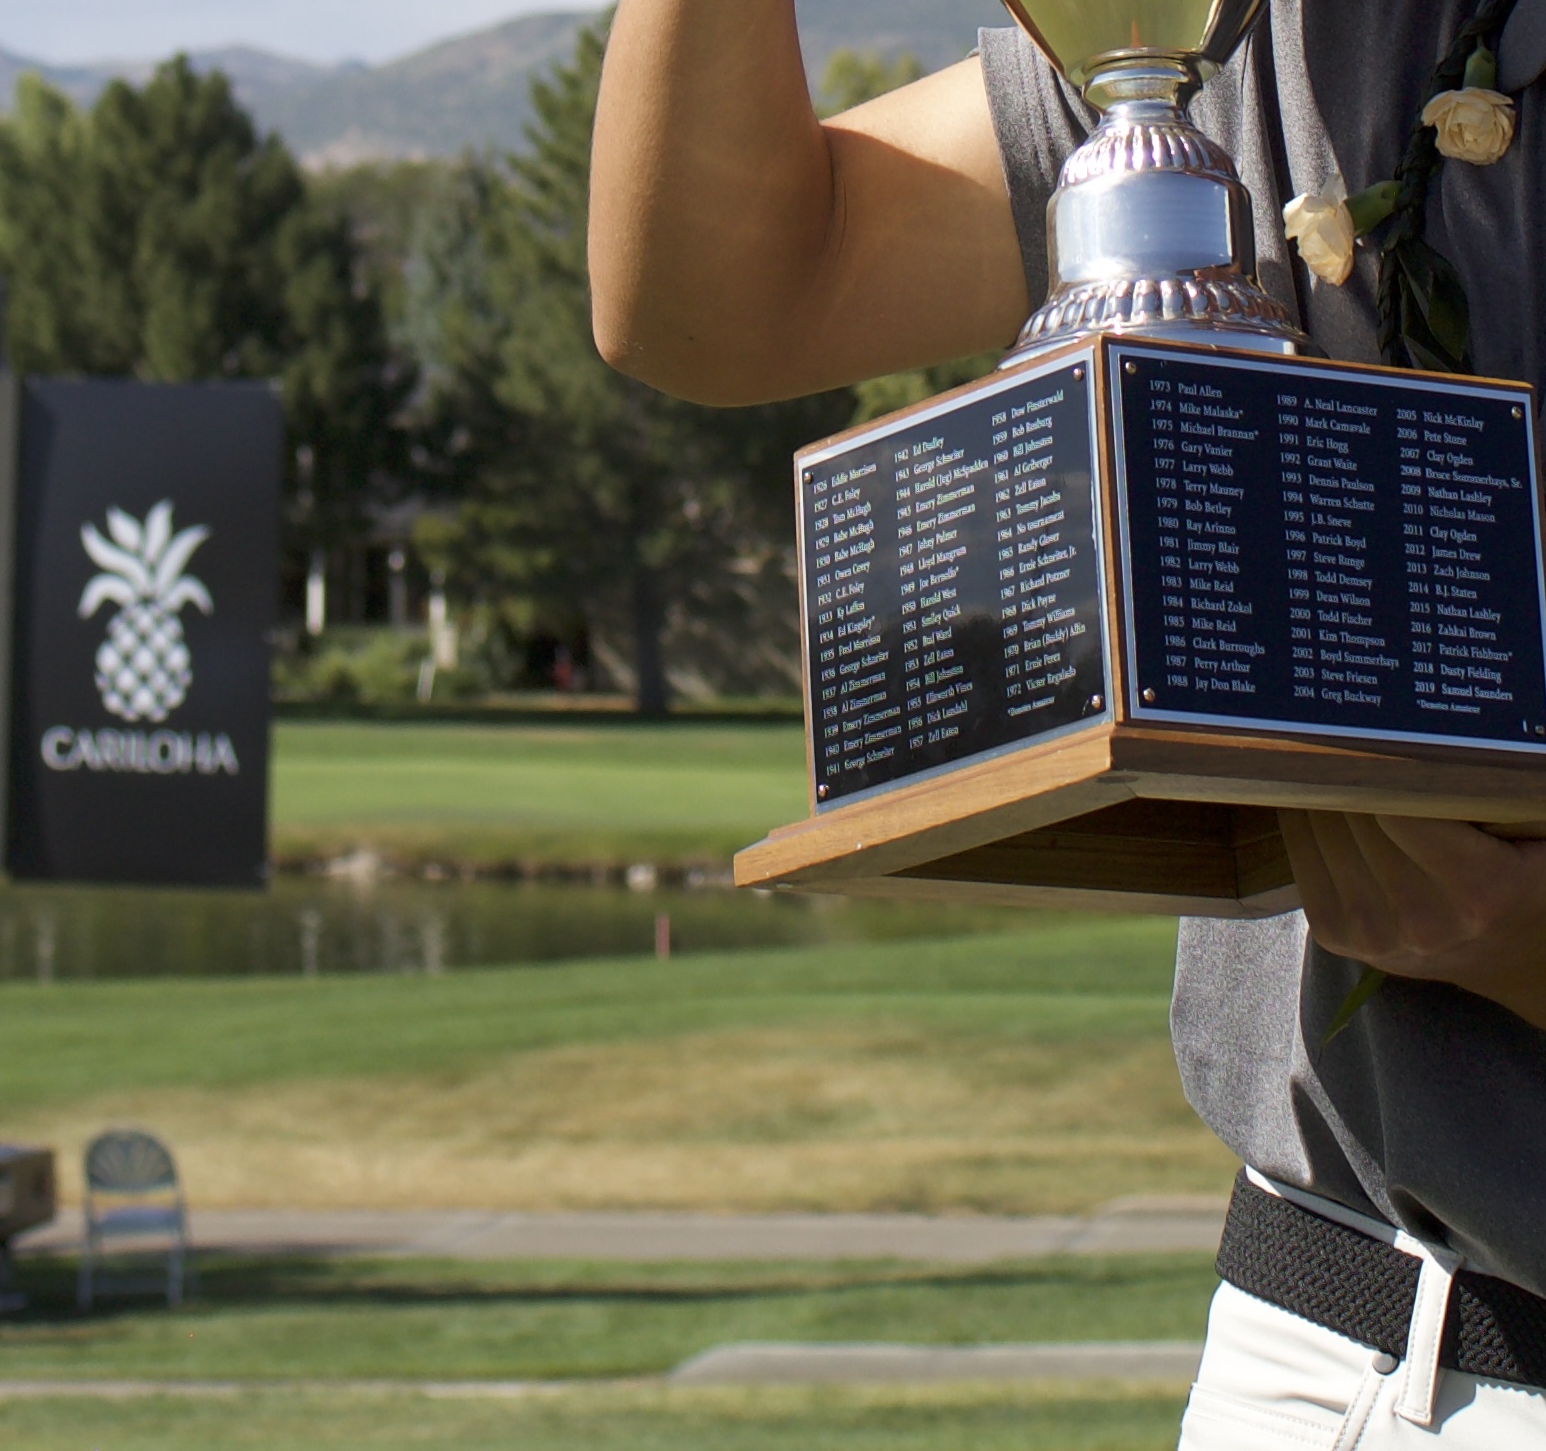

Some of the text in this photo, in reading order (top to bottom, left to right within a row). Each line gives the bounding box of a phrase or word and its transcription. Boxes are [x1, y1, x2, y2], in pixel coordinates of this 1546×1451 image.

[1149, 379, 1170, 392] 1973
[1150, 399, 1171, 411] 1974
[1152, 418, 1172, 430] 1975
[1153, 437, 1174, 450] 1976
[1154, 457, 1174, 469] 1977
[1155, 477, 1176, 489] 1978
[1402, 502, 1423, 514] 2010
[1403, 523, 1422, 535] 2011
[1406, 561, 1426, 573] 2013
[1410, 621, 1431, 633] 2016
[1413, 661, 1433, 673] 2018
[1414, 680, 1434, 692] 2019
[40, 725, 240, 775] CARILOHA
